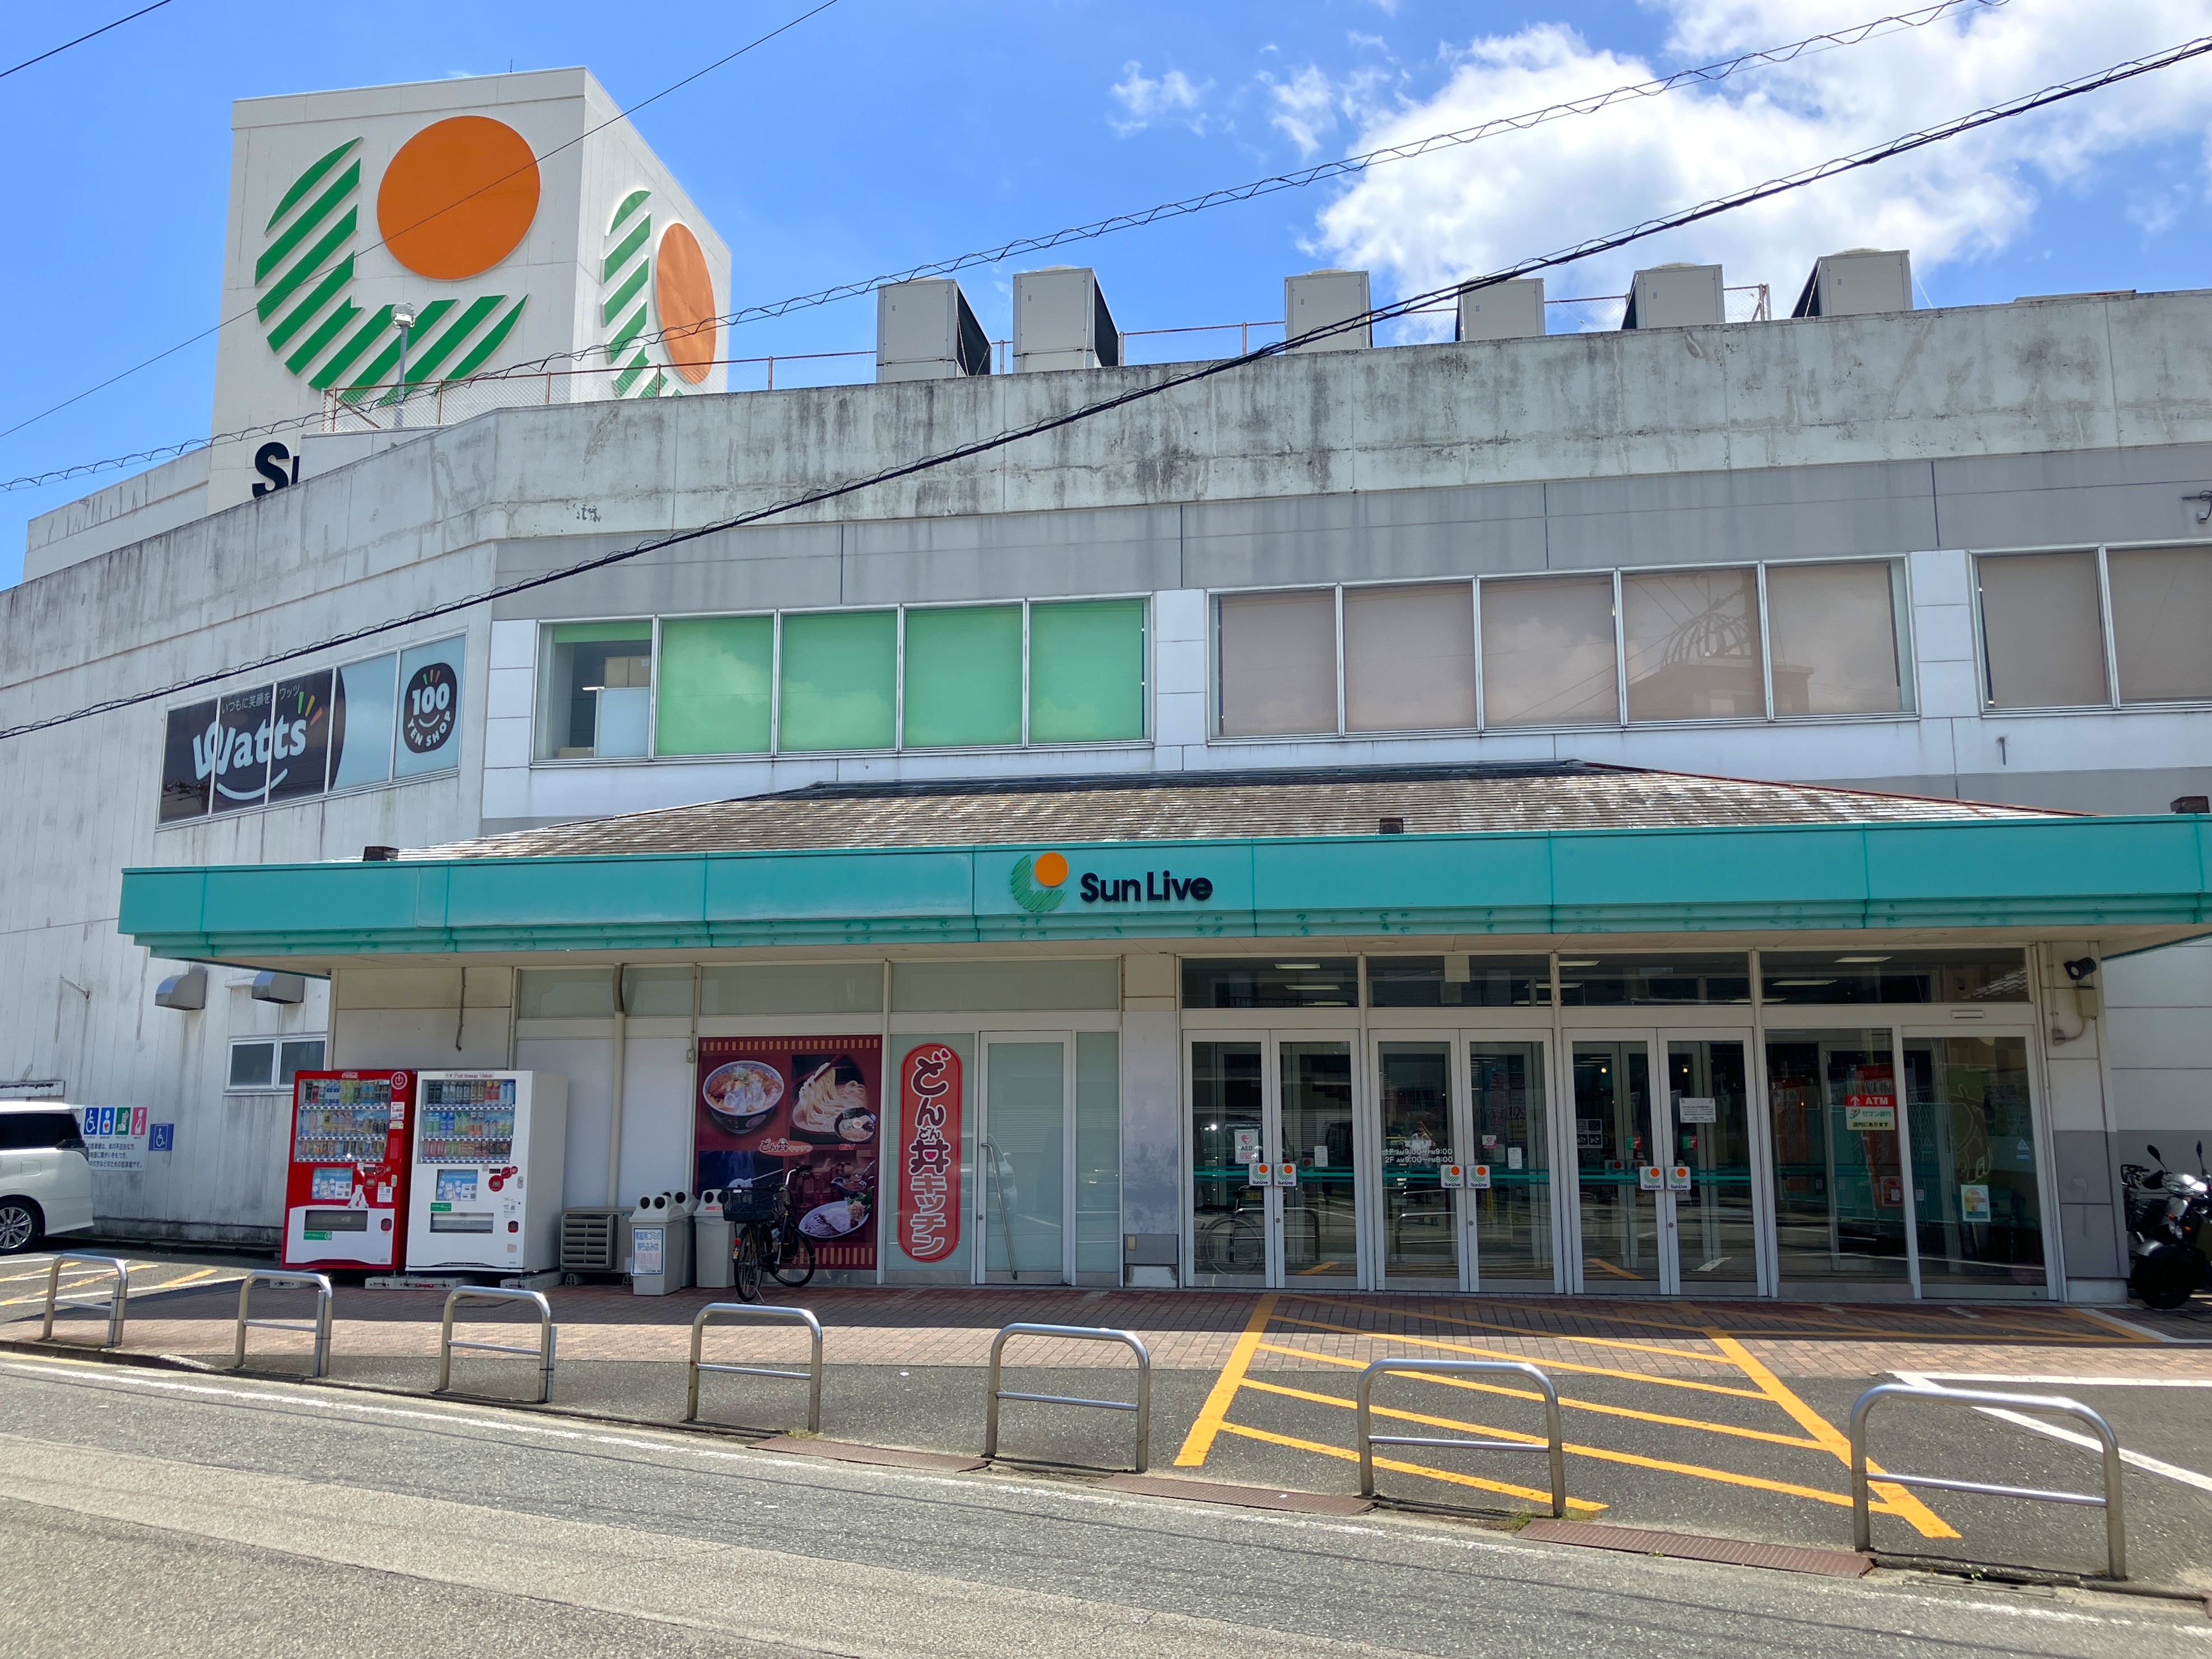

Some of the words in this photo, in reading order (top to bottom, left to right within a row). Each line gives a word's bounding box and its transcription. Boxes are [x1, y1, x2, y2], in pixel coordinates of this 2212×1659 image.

[412, 682, 450, 716] 100
[407, 717, 423, 746] YEN
[425, 710, 451, 747] SHOP
[192, 714, 307, 781] Watts
[1865, 1097, 1889, 1105] ATM
